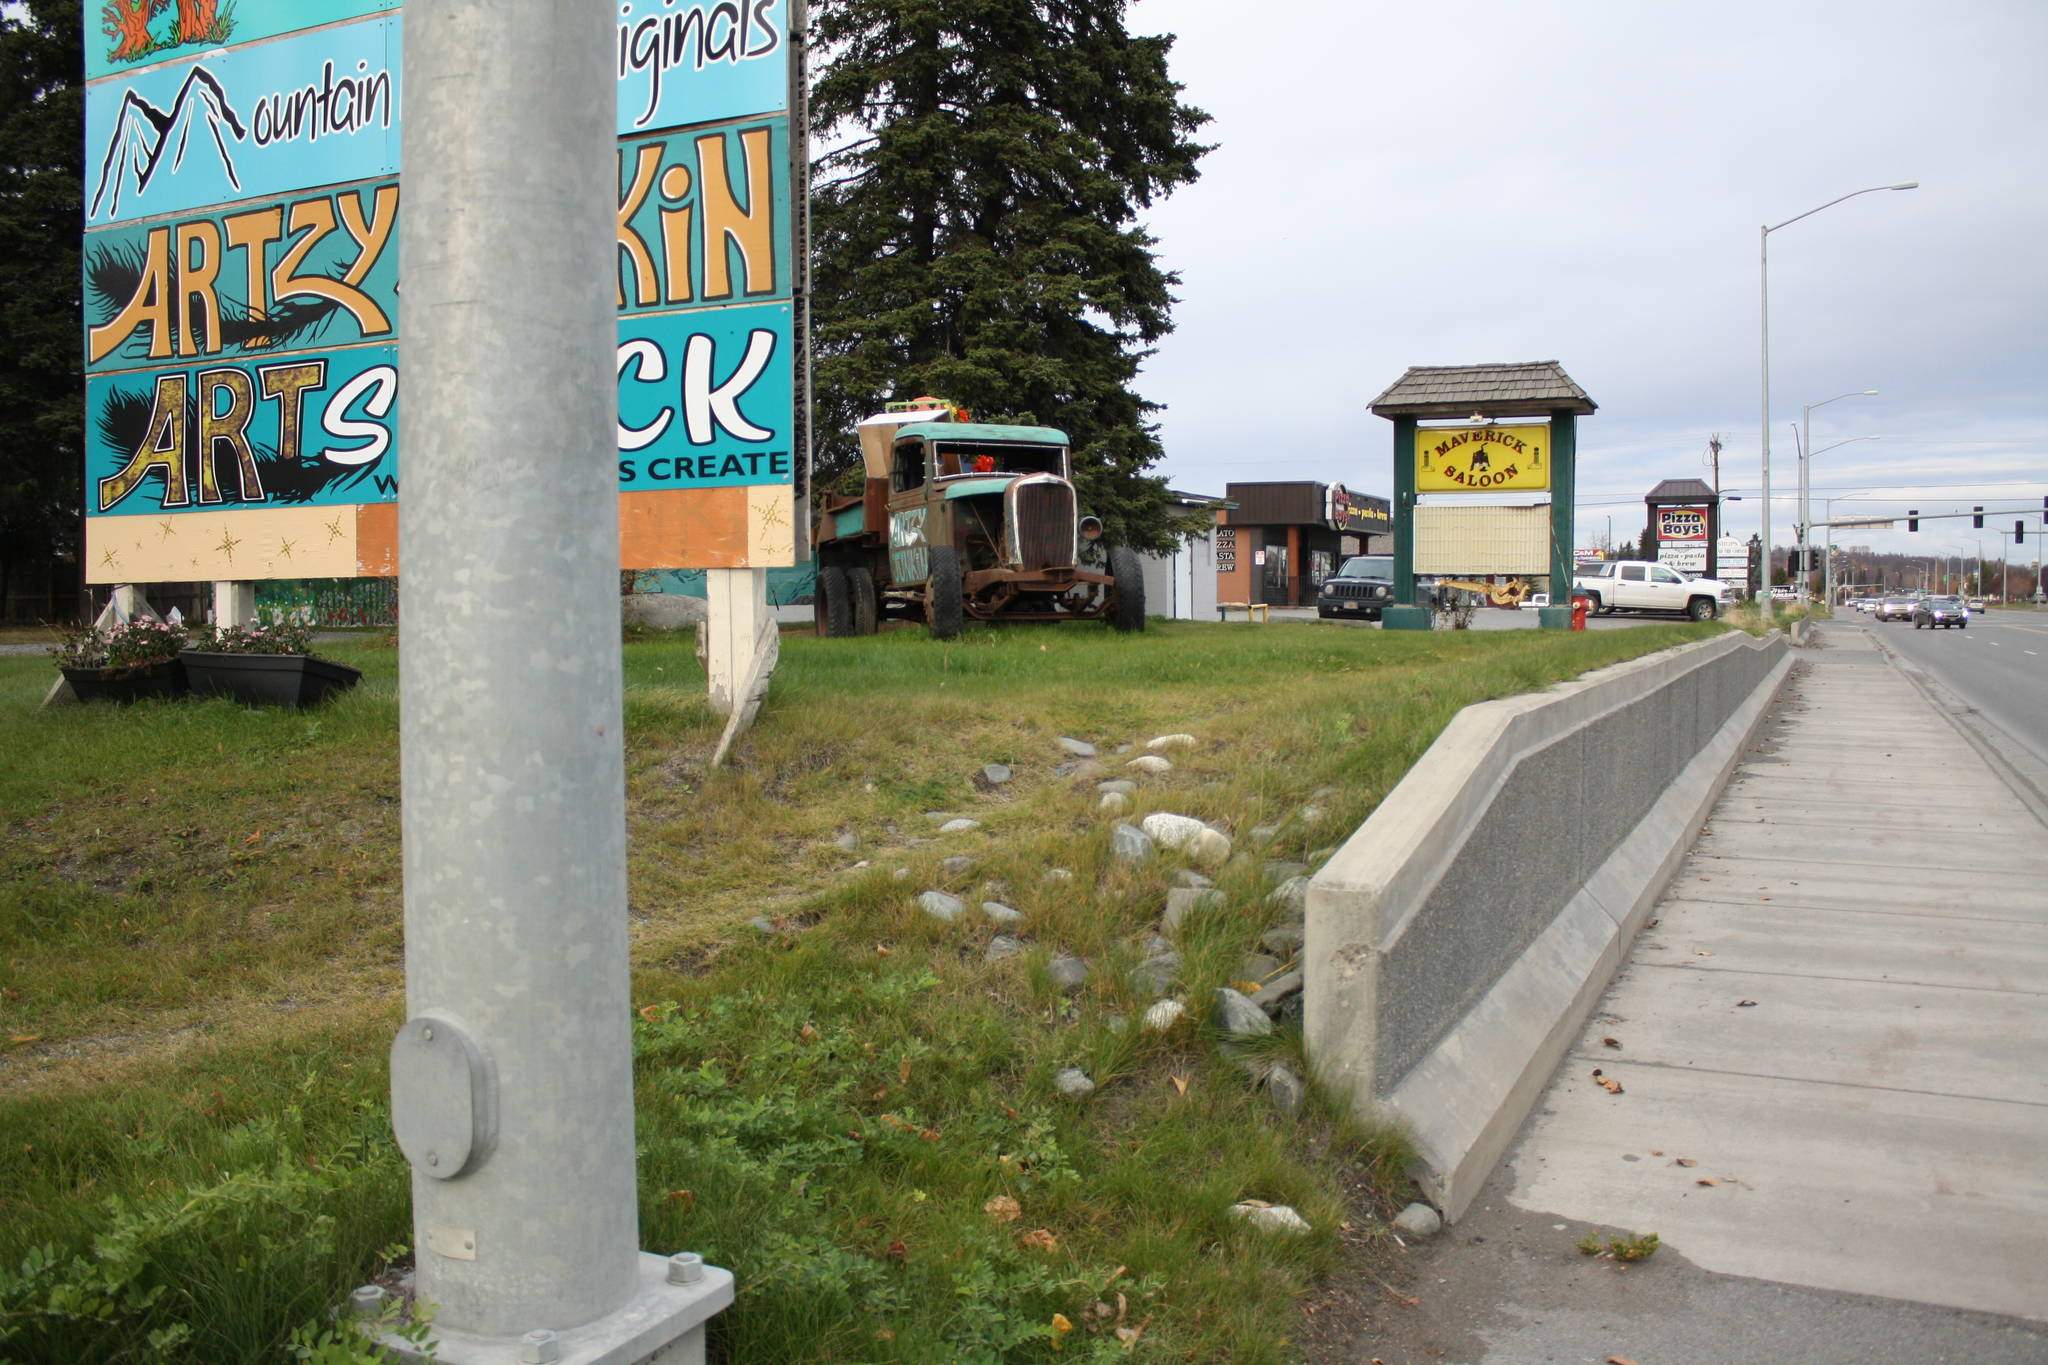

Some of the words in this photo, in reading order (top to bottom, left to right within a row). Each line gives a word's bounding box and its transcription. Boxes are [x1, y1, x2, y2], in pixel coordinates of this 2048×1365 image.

[88, 185, 398, 364] ARTZY
[1434, 430, 1527, 457] MAVERICK
[648, 451, 788, 480] CREATE
[1444, 463, 1519, 487] SALOON
[1661, 512, 1701, 524] Pizza
[1663, 523, 1704, 535] Boys!
[1216, 563, 1235, 571] REW
